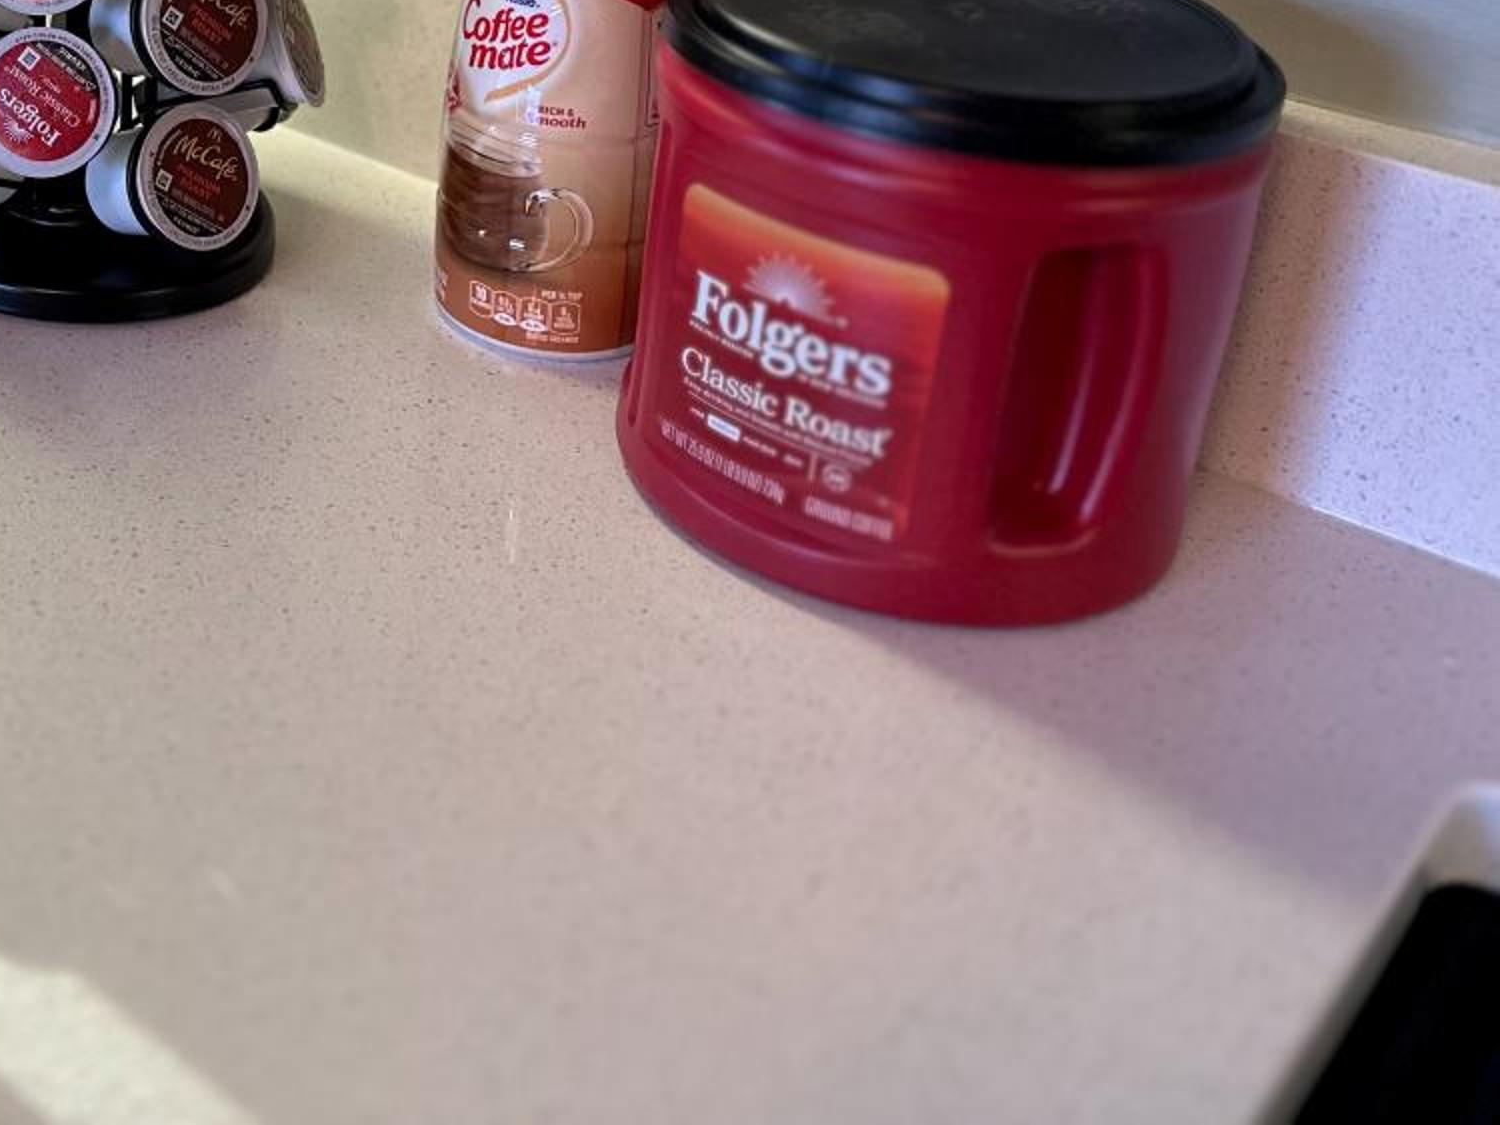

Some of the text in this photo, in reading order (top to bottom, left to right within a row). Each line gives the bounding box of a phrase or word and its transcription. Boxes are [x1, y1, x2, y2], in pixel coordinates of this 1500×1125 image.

[468, 39, 550, 70] mate
[9, 65, 41, 98] Roast
[39, 95, 81, 128] Classic
[173, 134, 238, 181] McCafé
[691, 268, 892, 397] Folgers
[682, 347, 779, 418] Classic
[784, 396, 886, 458] Roast
